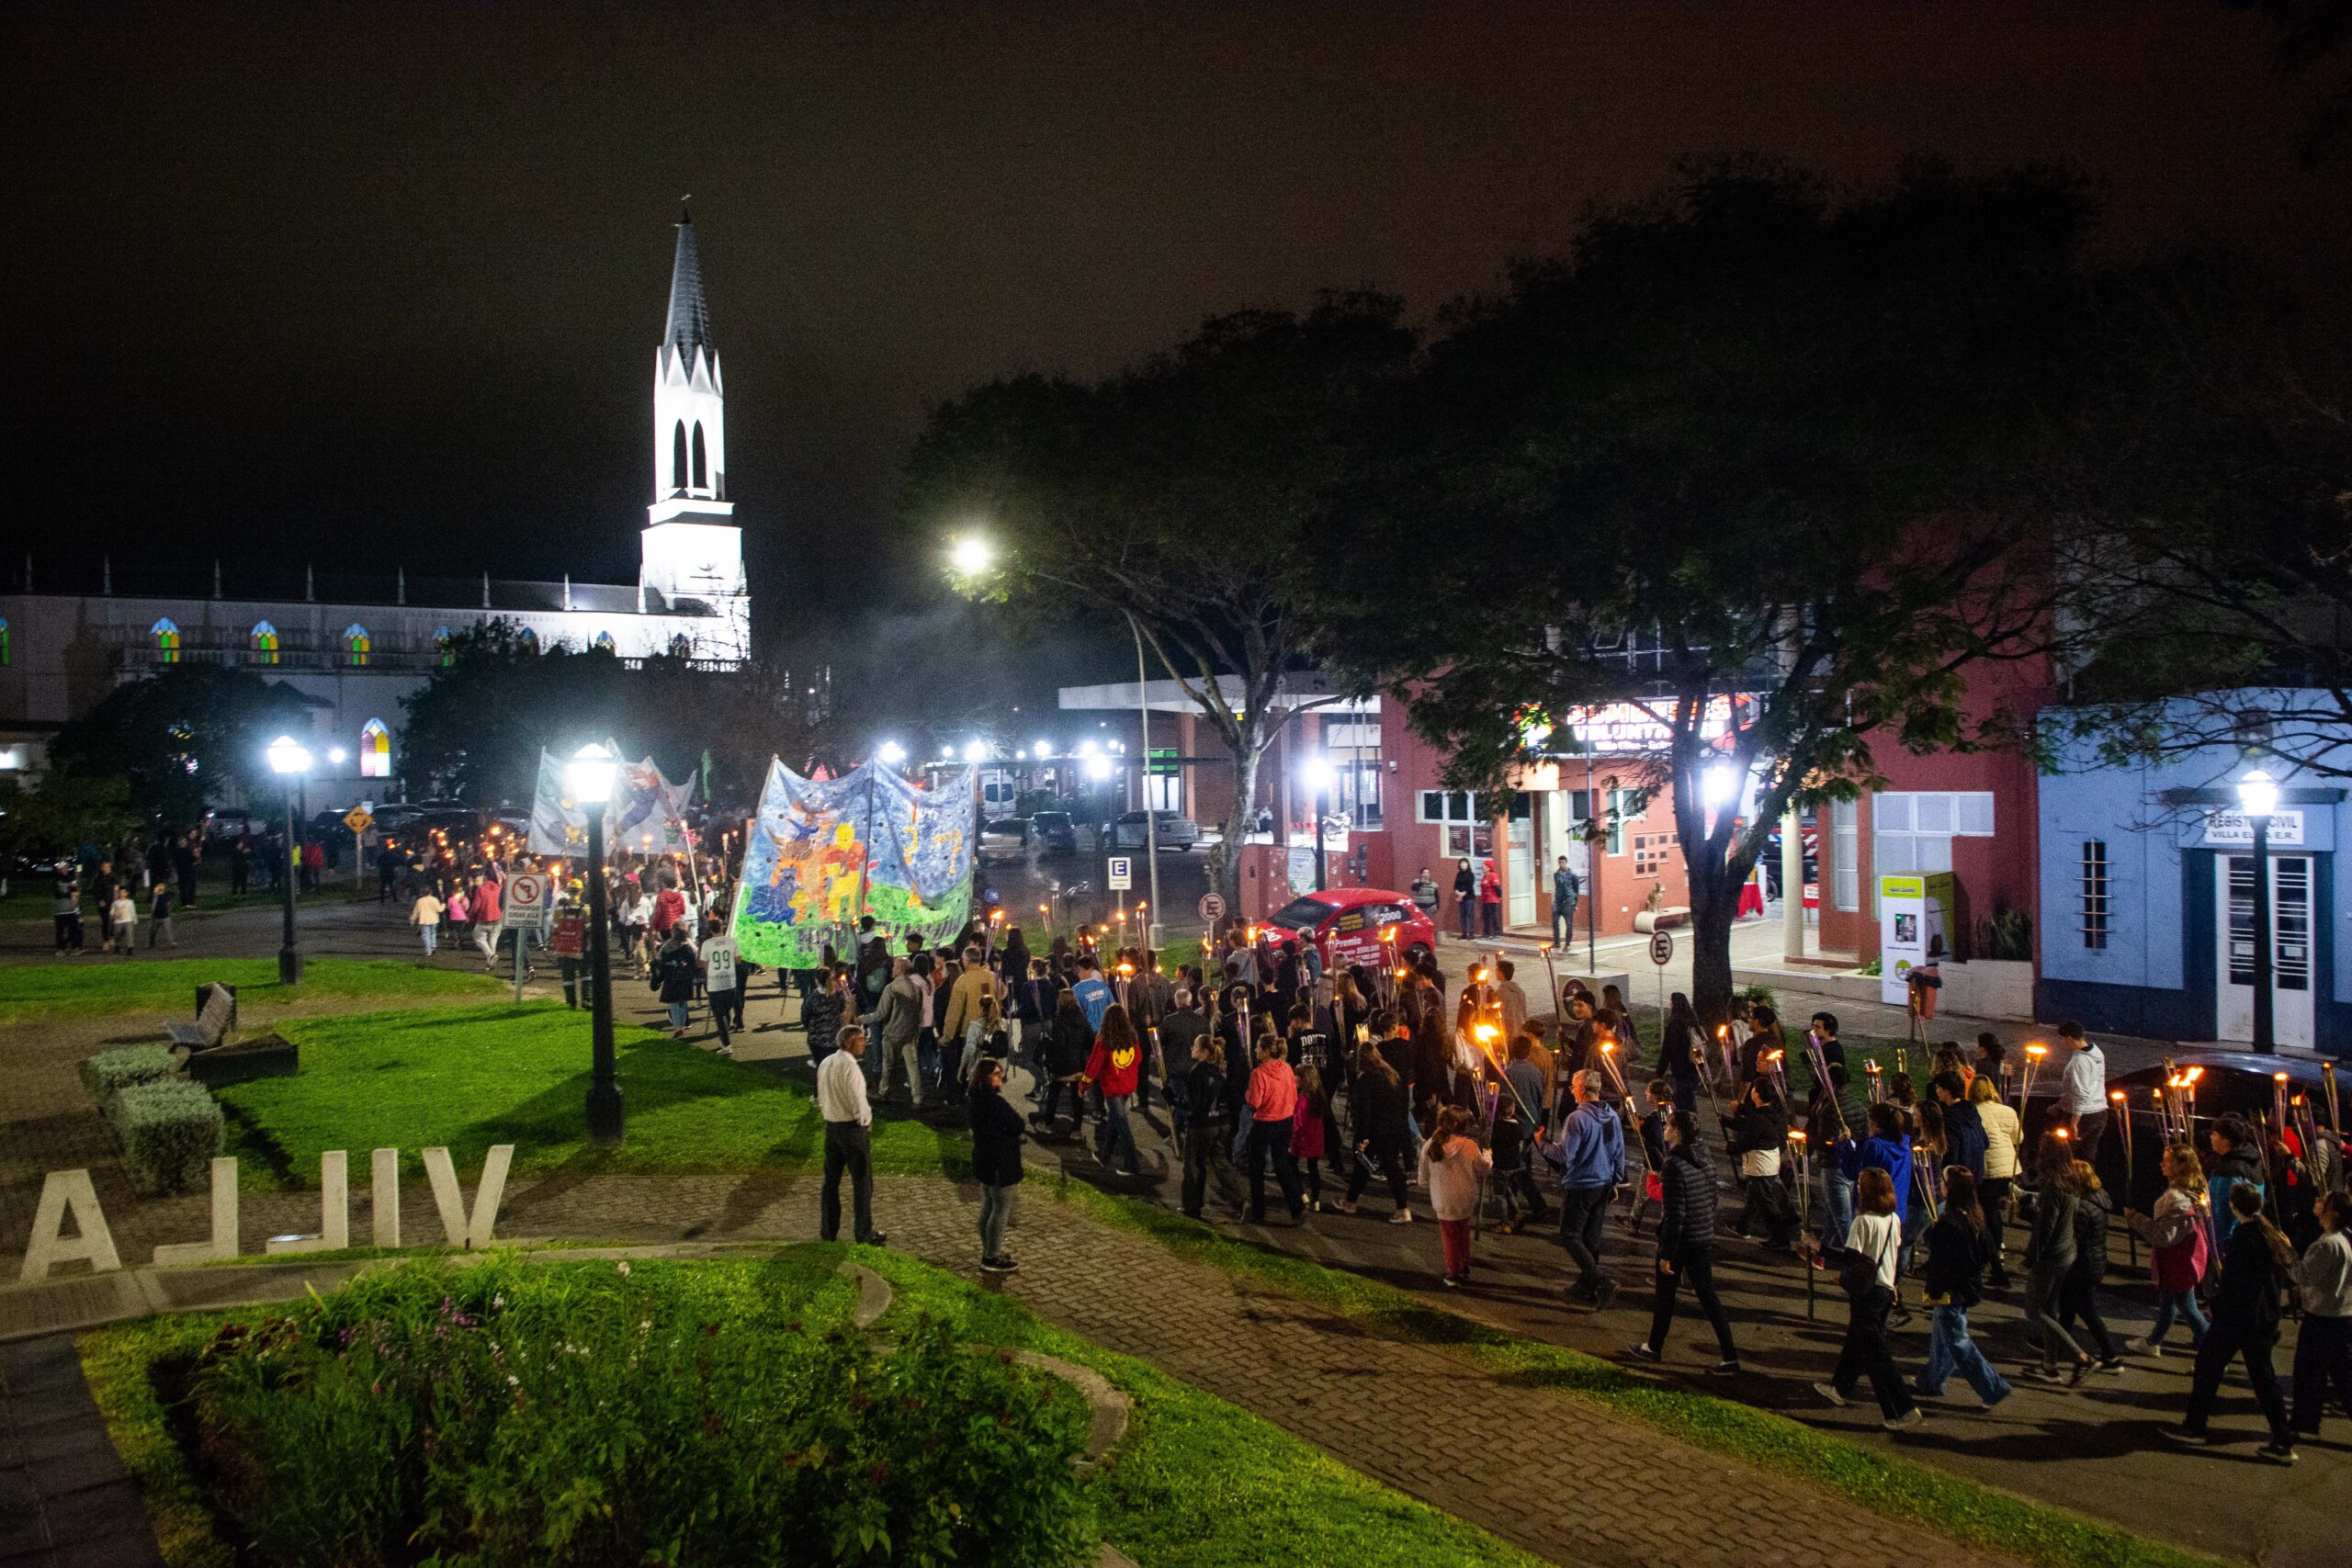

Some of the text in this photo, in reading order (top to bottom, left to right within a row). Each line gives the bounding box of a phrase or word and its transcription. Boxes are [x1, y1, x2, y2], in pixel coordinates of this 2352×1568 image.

[2211, 830, 2240, 839] VILLA
[1114, 862, 1125, 874] E
[1380, 910, 1402, 923] 2000
[1656, 939, 1668, 958] E
[712, 950, 730, 970] 99
